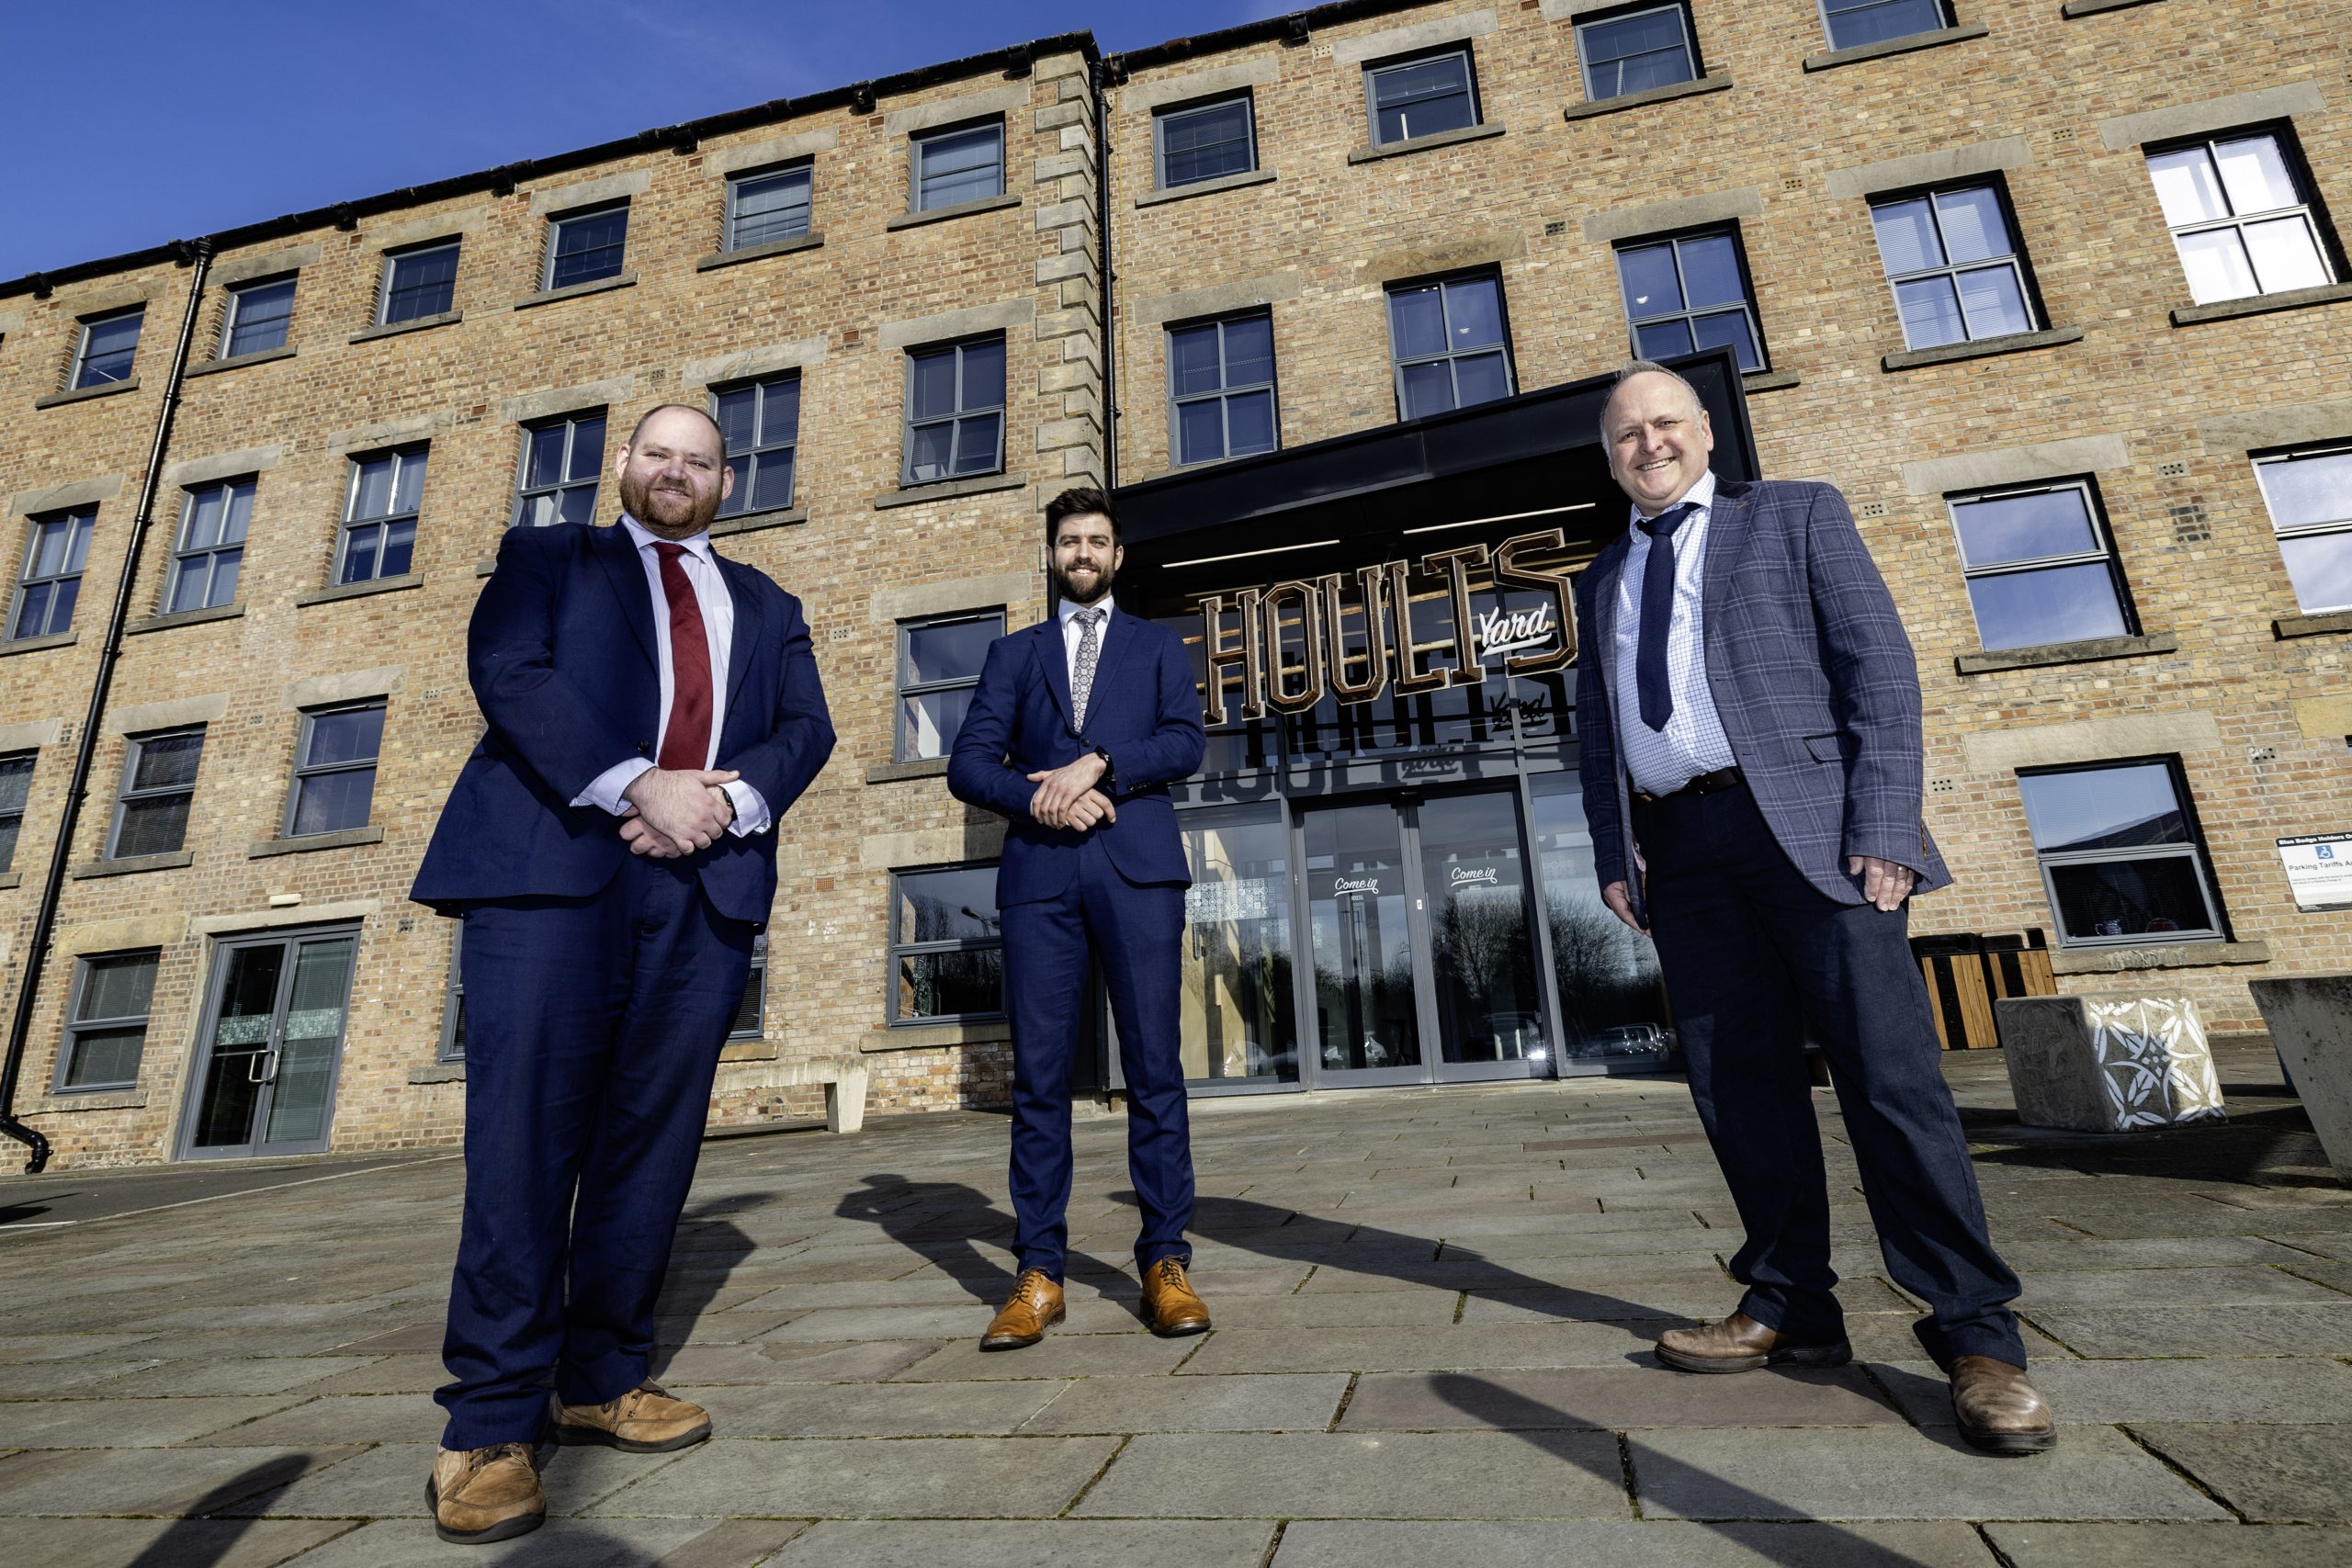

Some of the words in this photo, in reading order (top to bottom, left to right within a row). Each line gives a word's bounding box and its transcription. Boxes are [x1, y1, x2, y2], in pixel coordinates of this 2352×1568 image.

[1199, 527, 1578, 728] HOULTS
[1479, 601, 1551, 653] Yard
[1334, 877, 1366, 893] Come
[1367, 877, 1378, 892] in
[1451, 866, 1484, 883] Come
[1485, 866, 1497, 882] in
